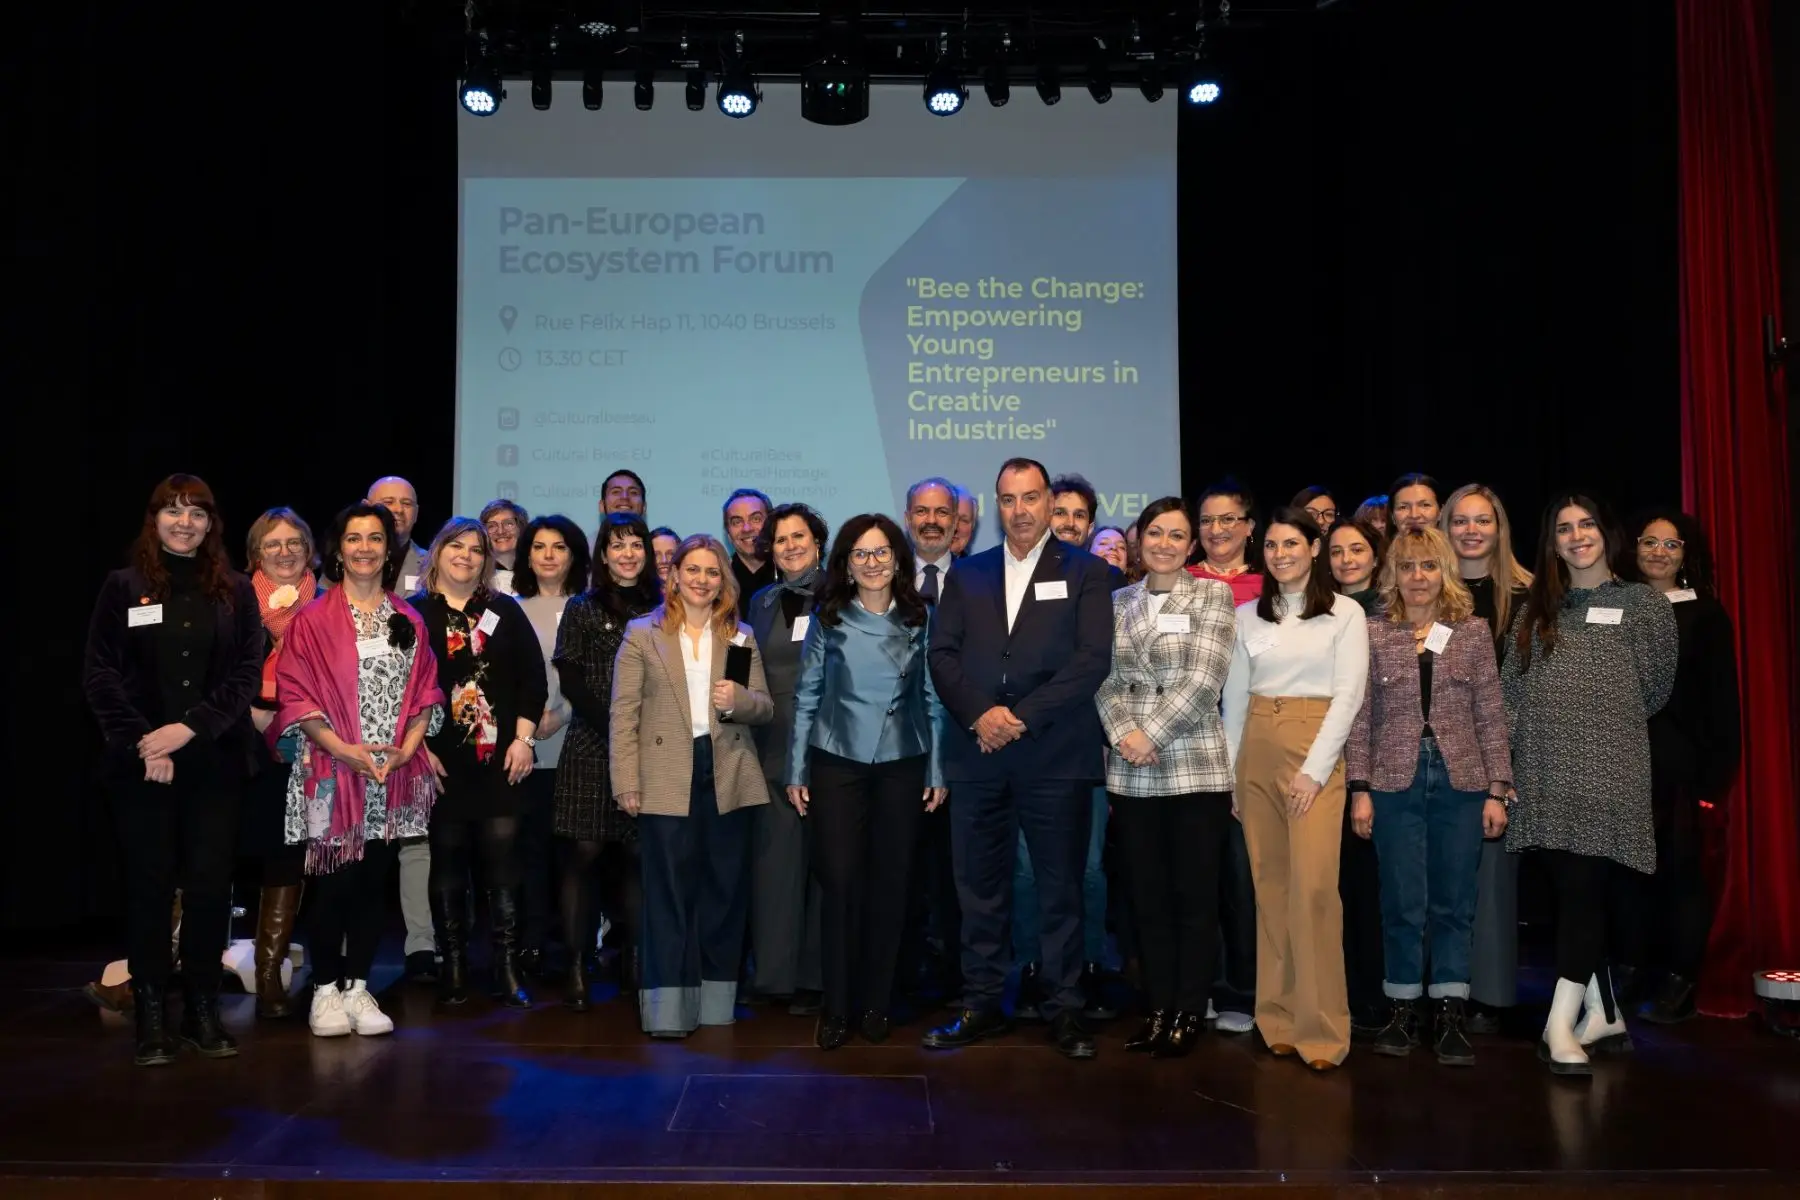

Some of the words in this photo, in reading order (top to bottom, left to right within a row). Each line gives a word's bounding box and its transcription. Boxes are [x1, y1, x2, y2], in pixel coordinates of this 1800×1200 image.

[499, 206, 765, 242] Pan-European
[499, 245, 699, 281] Ecosystem
[712, 245, 833, 274] Forum
[907, 277, 970, 300] "Bee
[978, 277, 1024, 300] the
[1031, 277, 1144, 305] Change:
[535, 314, 573, 331] Rue
[632, 314, 671, 333] Hap
[676, 314, 696, 332] 11,
[701, 313, 747, 330] 1040
[754, 311, 836, 331] Brussels
[907, 305, 1083, 332] Empowering
[536, 350, 582, 366] 13.30
[589, 350, 628, 366] CET
[908, 335, 995, 360] Young
[908, 362, 1107, 389] Entrepreneurs
[1112, 361, 1138, 384] in
[907, 389, 1022, 414] Creative
[909, 416, 1057, 443] Industries"
